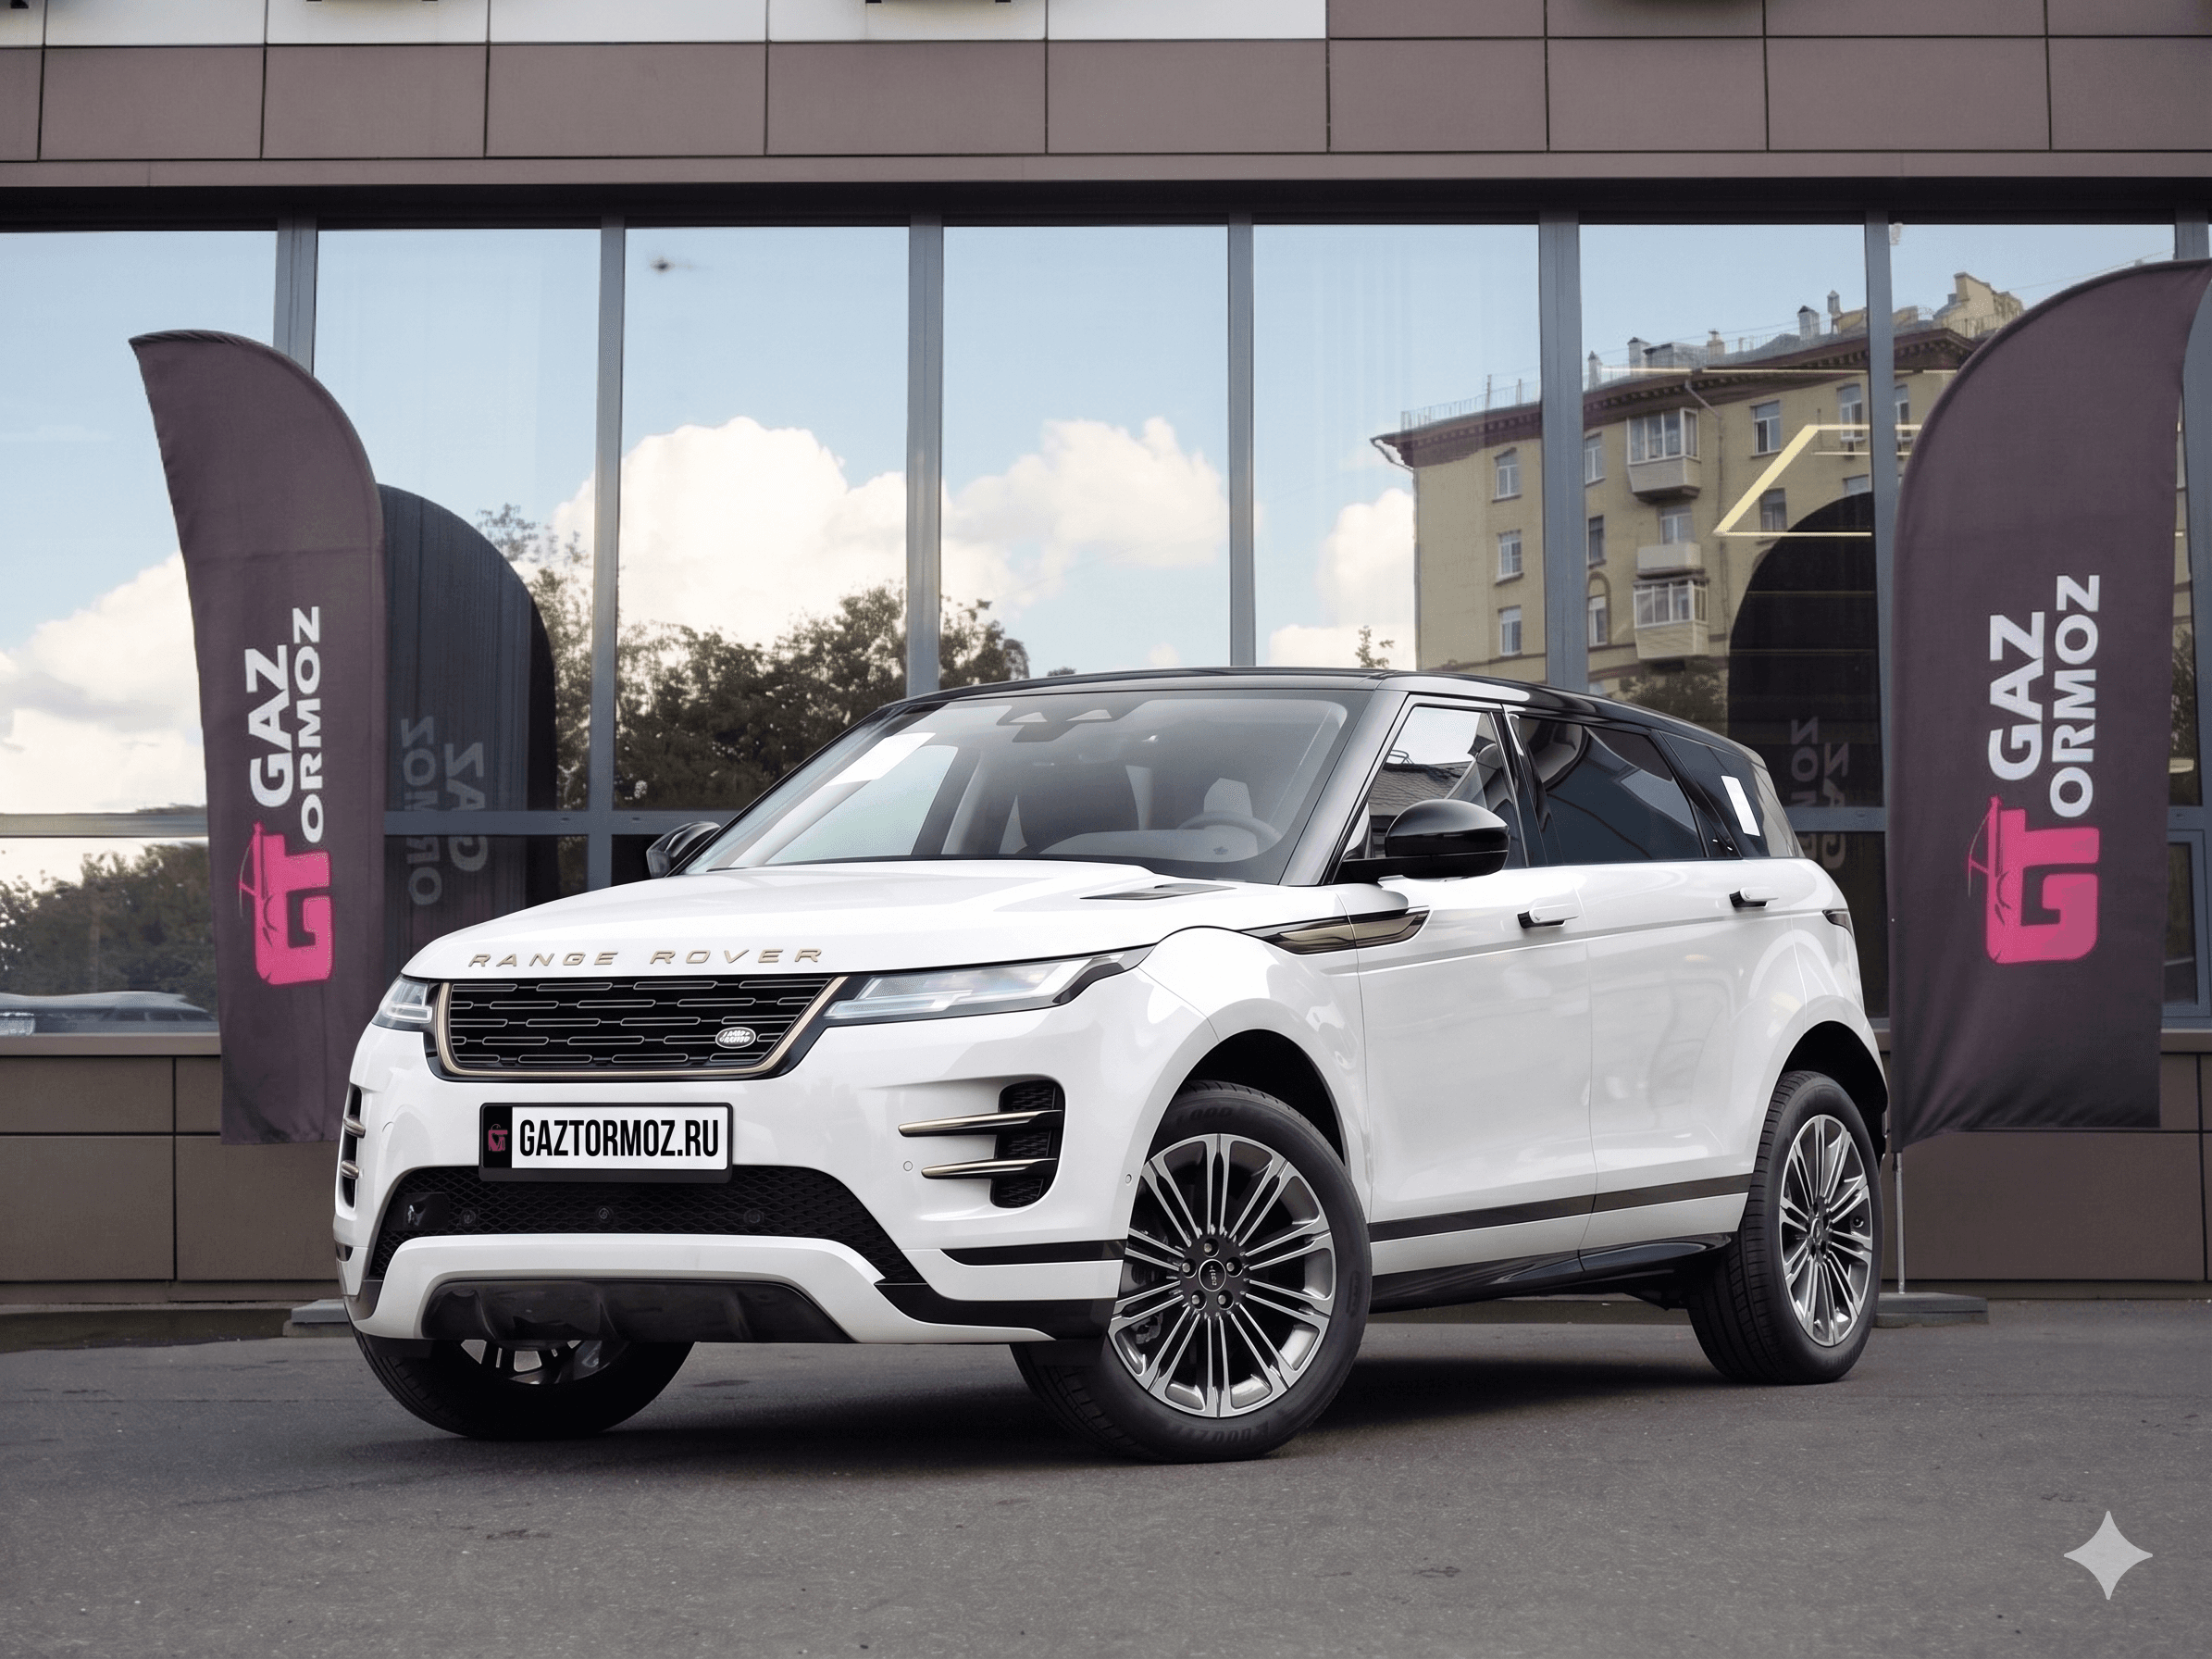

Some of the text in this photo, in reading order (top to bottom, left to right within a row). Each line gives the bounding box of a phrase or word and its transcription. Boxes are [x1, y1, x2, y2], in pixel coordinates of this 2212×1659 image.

[244, 644, 293, 807] GAZ
[292, 606, 324, 843] ORMOZ
[1988, 611, 2044, 780] GAZ
[2049, 575, 2100, 817] ORMOZ
[468, 948, 823, 967] RANGE ROVER
[519, 1119, 719, 1157] GAZTORMOZ.RU
